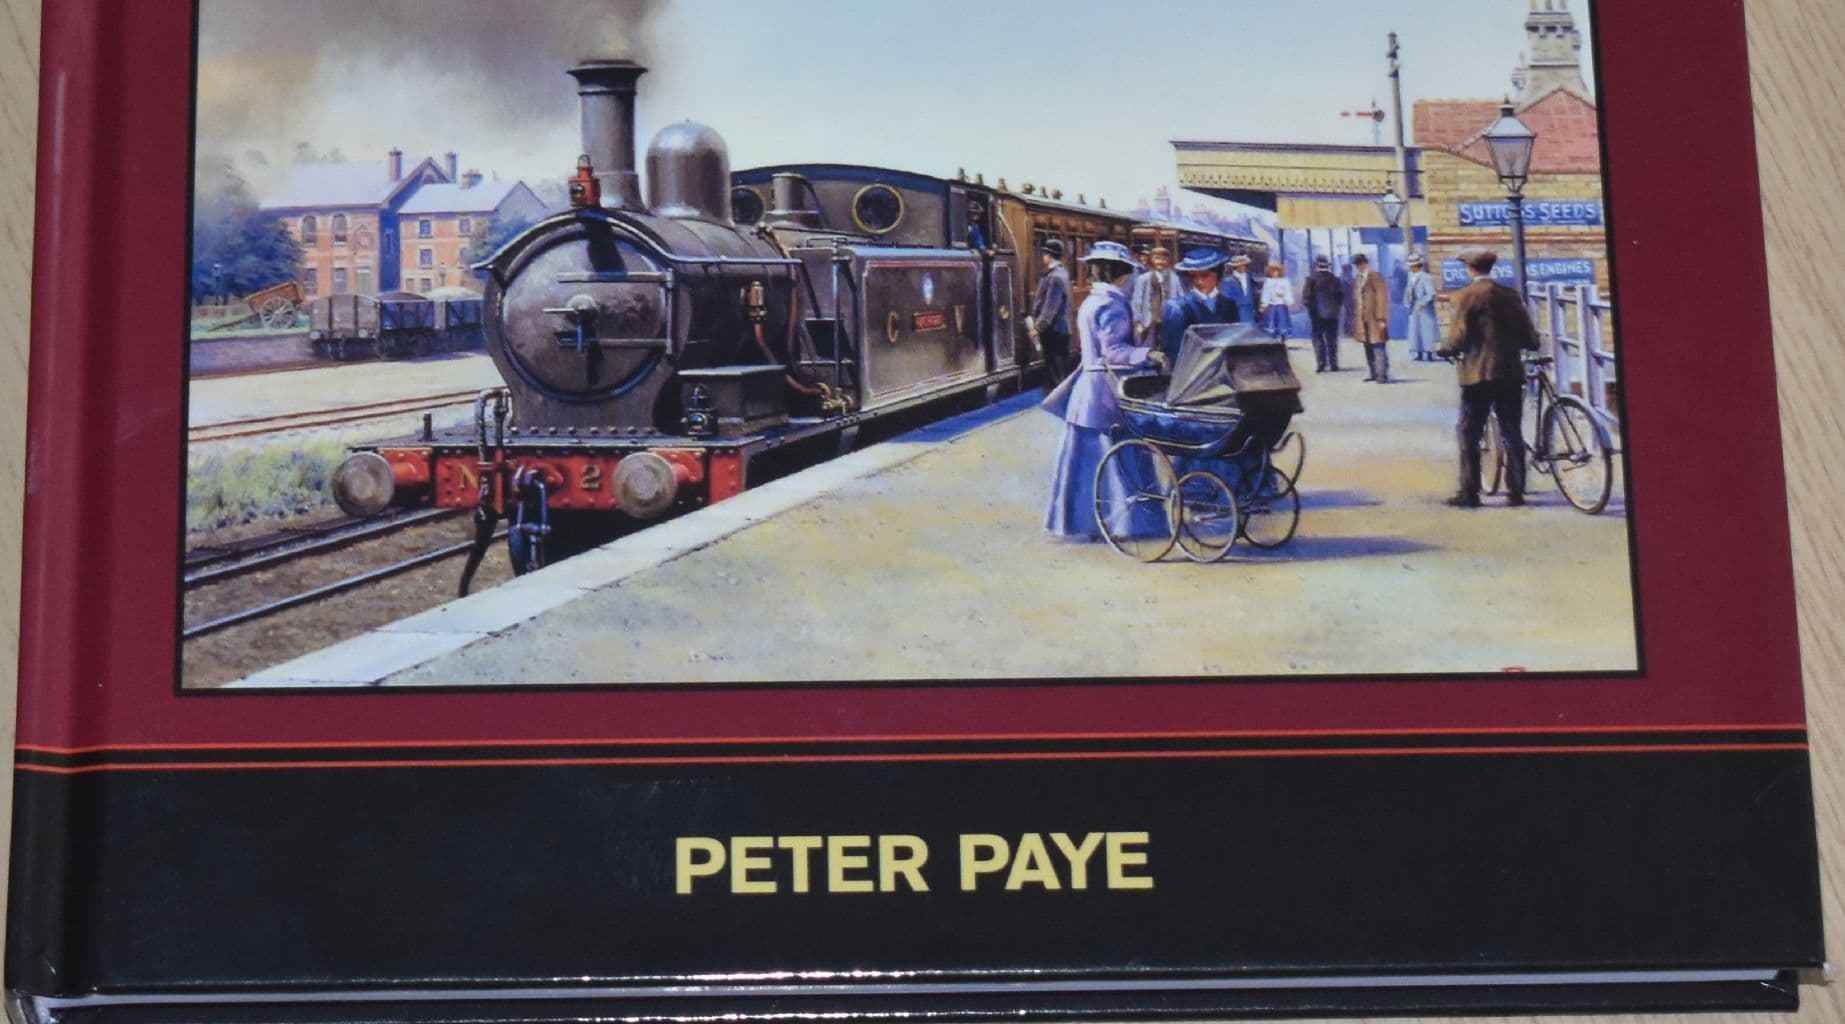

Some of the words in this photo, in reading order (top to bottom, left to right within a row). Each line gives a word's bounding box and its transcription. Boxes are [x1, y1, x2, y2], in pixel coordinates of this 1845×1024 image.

[1460, 203, 1536, 224] SUTTOS
[1540, 203, 1595, 222] SEEDS
[580, 464, 602, 490] 2
[675, 833, 931, 897] PETER
[959, 829, 1155, 893] PAYE
